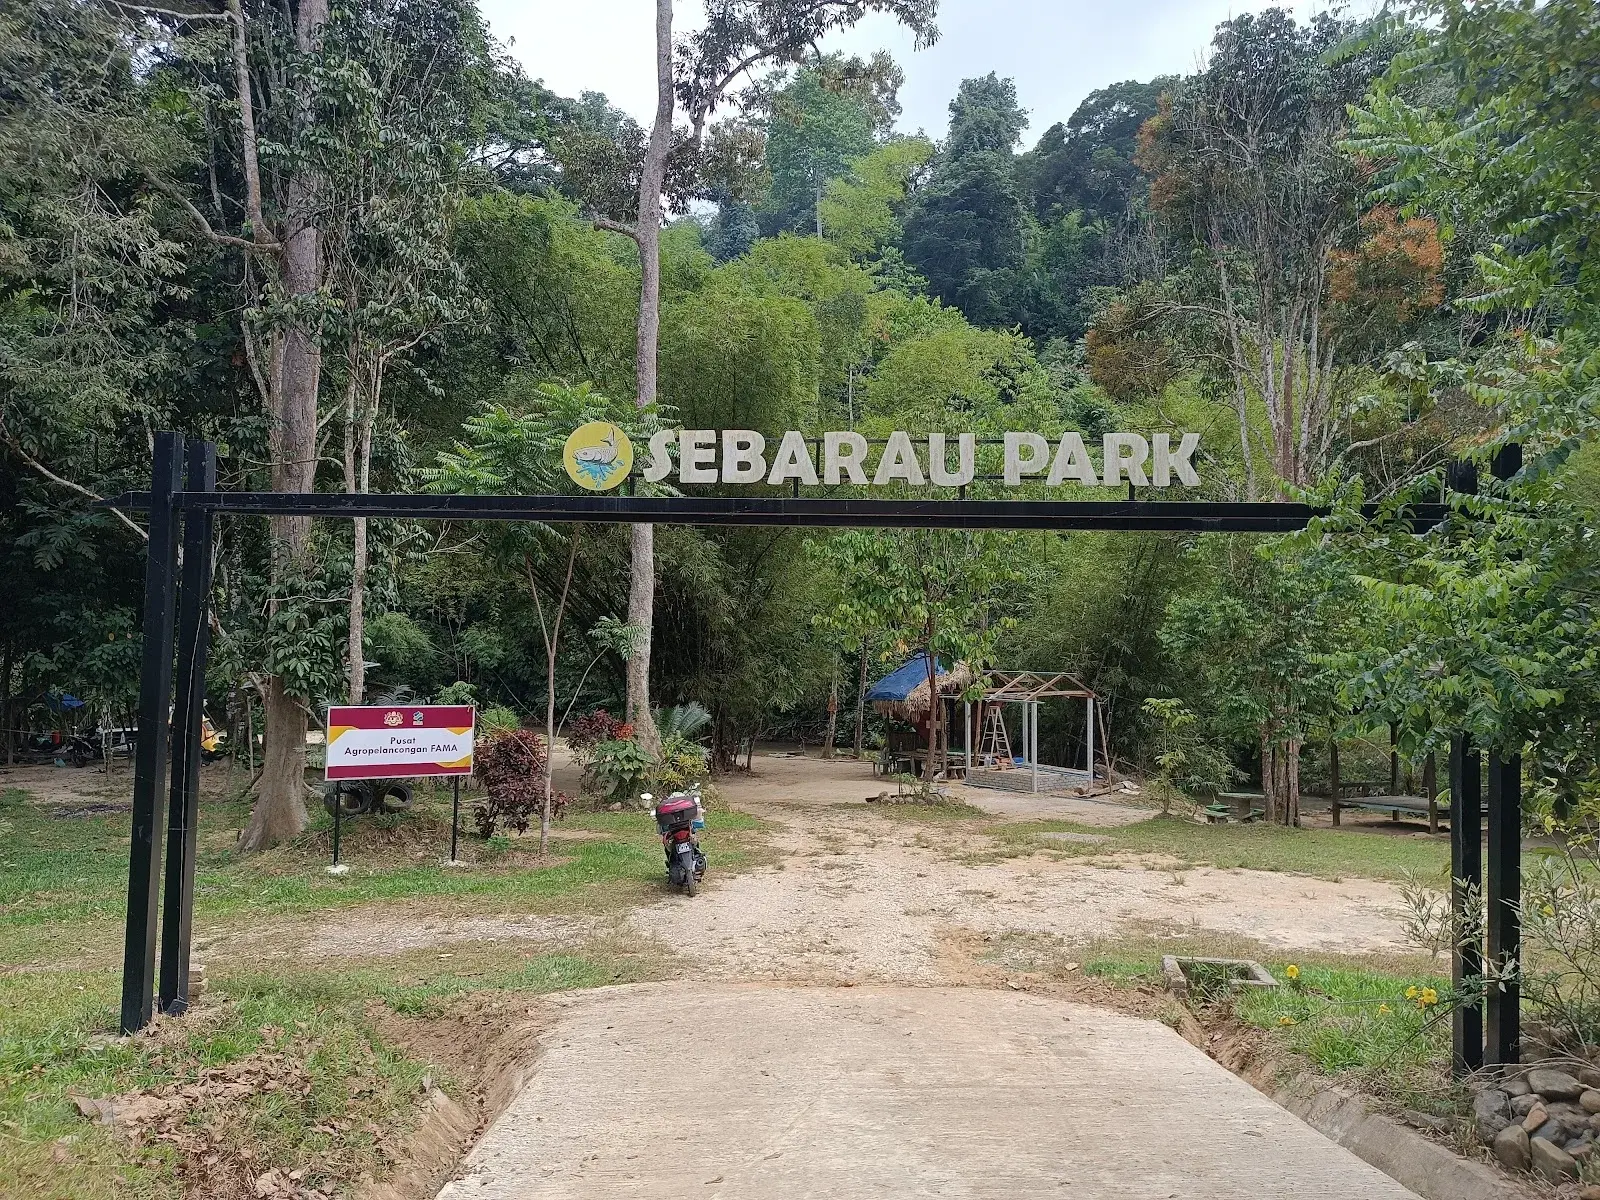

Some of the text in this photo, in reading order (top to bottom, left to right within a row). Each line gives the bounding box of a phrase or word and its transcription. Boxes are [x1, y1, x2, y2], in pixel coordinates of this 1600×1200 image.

[643, 429, 1201, 488] SEBARAU PARK
[390, 737, 416, 745] Pusat
[344, 744, 458, 756] Agropelancongan FAMA
